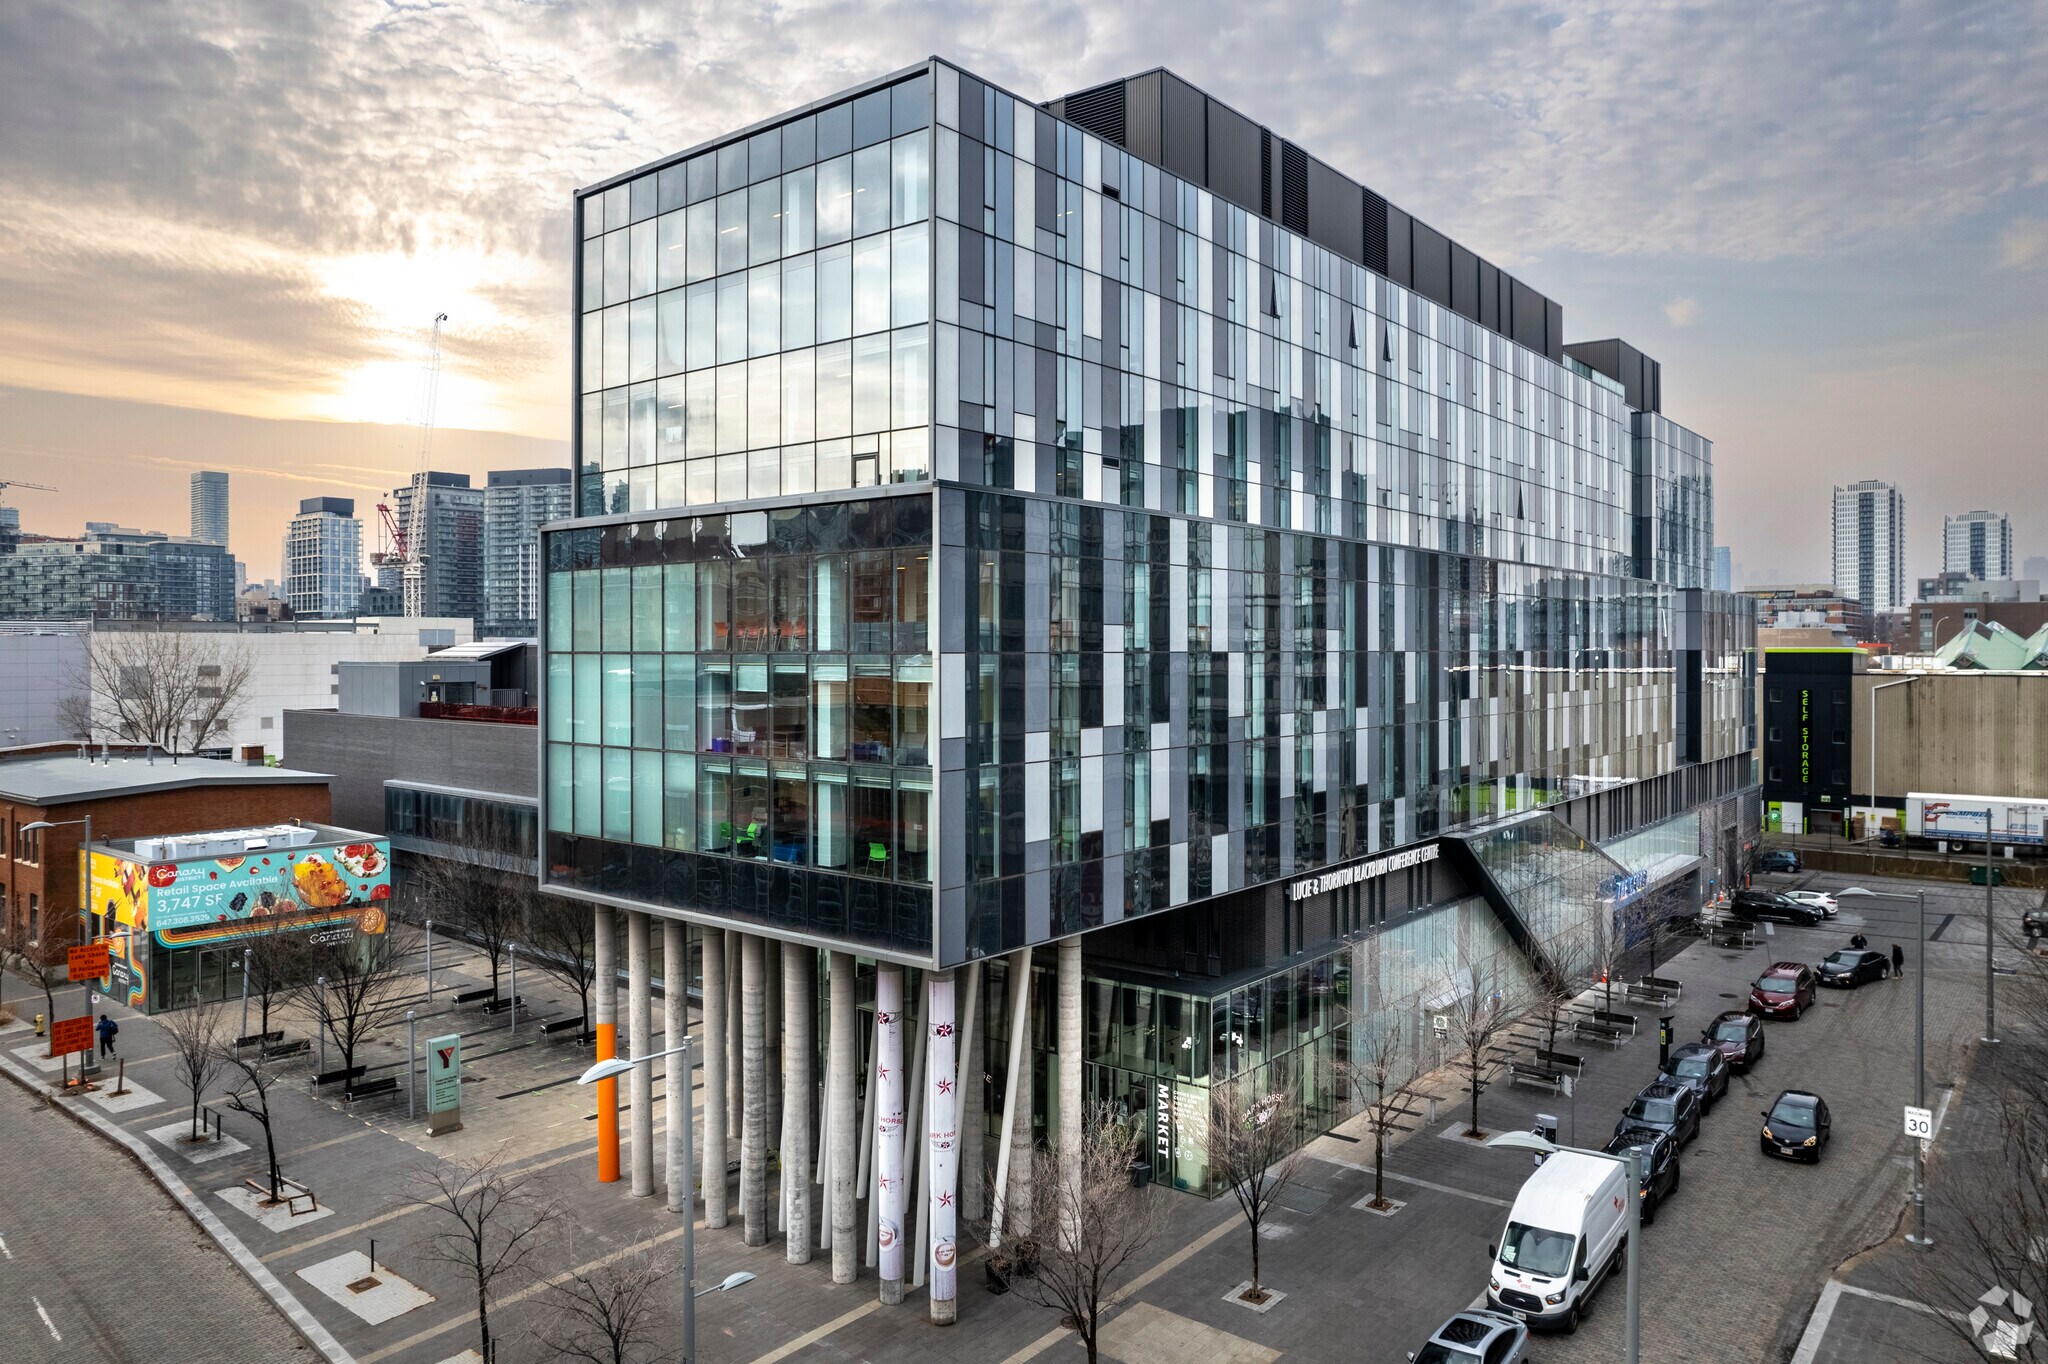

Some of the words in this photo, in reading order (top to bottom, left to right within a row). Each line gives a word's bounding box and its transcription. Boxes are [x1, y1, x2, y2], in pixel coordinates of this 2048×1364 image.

[156, 867, 206, 880] Canary
[1292, 879, 1312, 901] LUCIE
[1313, 882, 1319, 895] &
[1319, 867, 1353, 893] THORNTON
[1354, 859, 1387, 883] BLACKBURN
[1388, 848, 1420, 872] CONFERENCE
[1421, 843, 1440, 863] CENTRE
[157, 885, 189, 898] Retail
[192, 882, 226, 895] Space
[229, 876, 278, 889] Available
[157, 896, 200, 913] 3,747
[206, 893, 224, 907] SF
[1157, 1083, 1169, 1160] MARKET
[1908, 1110, 1930, 1118] MAXIMUM
[1908, 1119, 1929, 1134] 30
